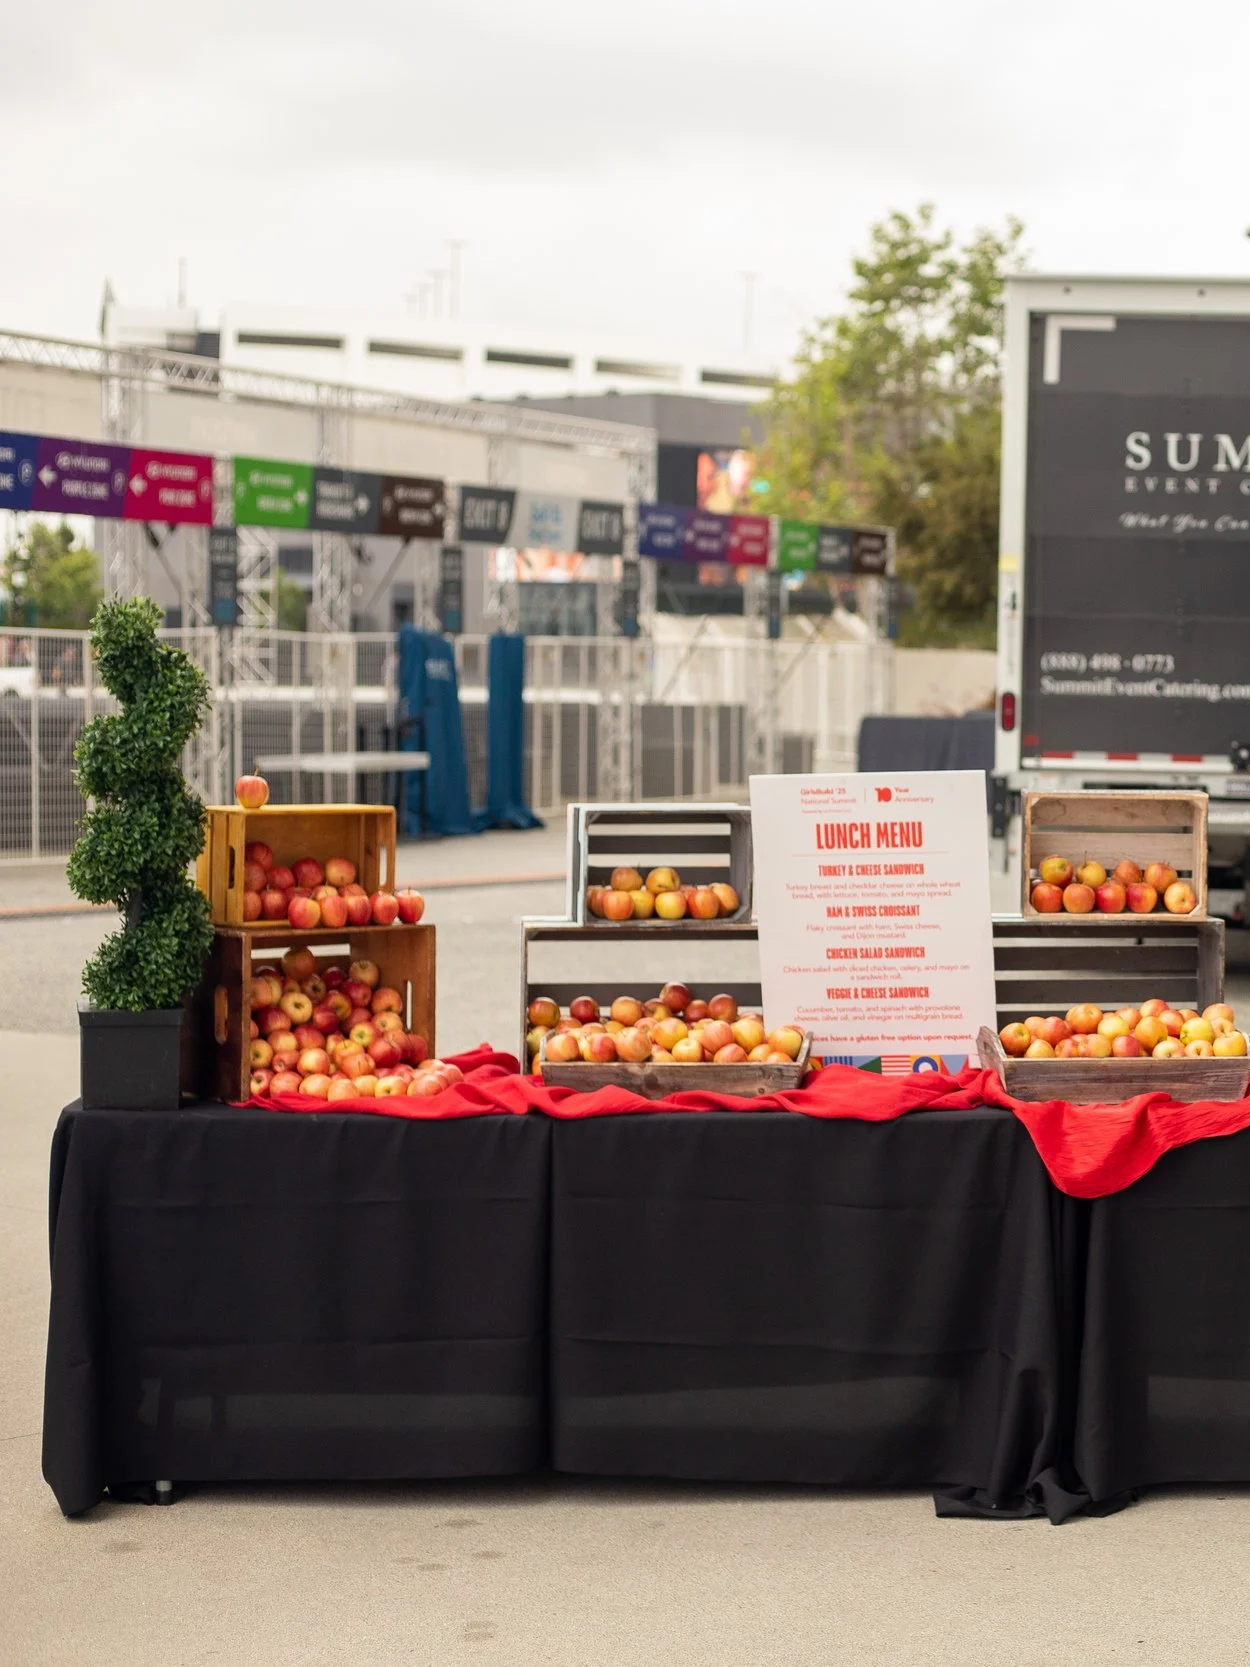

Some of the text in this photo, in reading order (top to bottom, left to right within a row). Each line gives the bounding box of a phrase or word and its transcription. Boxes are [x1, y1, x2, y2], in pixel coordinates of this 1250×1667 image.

[1124, 476, 1221, 495] EVENT
[1040, 651, 1088, 674] (888)
[1132, 653, 1175, 674] 0773
[816, 821, 924, 850] LUNCH MENU
[818, 865, 847, 877] TURKEY
[855, 864, 882, 876] CHEESE
[884, 863, 925, 876] SANDWICH
[785, 882, 808, 892] Turkey
[834, 882, 848, 890] and
[849, 881, 877, 890] cheddar
[879, 881, 905, 889] cheese
[917, 881, 938, 889] whole
[939, 880, 961, 889] wheat
[816, 891, 832, 899] with
[890, 890, 904, 898] and
[905, 891, 925, 900] mayo
[826, 906, 843, 918] HAM
[852, 905, 878, 917] SWISS
[878, 904, 921, 917] CROISSANT
[806, 923, 825, 932] Flaky
[858, 923, 873, 931] with
[894, 923, 914, 931] Swiss
[841, 932, 856, 940] and
[826, 946, 926, 960] CHICKEN SALAD SANDWICH
[783, 965, 812, 973] Chicken
[812, 965, 831, 973] salad
[832, 965, 848, 973] with
[849, 965, 869, 973] diced
[923, 963, 938, 972] and
[939, 964, 959, 973] mayo
[857, 973, 889, 981] sandwich
[826, 987, 853, 1000] VEGGIE
[860, 986, 887, 999] CHEESE
[889, 985, 930, 999] SANDWICH
[866, 1005, 880, 1013] and
[880, 1004, 908, 1014] spinach
[908, 1004, 924, 1012] with
[925, 1004, 961, 1013] provolone
[823, 1014, 840, 1022] olive
[851, 1013, 866, 1021] and
[867, 1013, 893, 1023] vinegar
[905, 1012, 940, 1022] multigrain
[830, 1034, 848, 1042] have
[856, 1034, 880, 1044] gluten
[896, 1034, 922, 1043] option
[922, 1035, 942, 1043] upon
[943, 1033, 973, 1043] request.
